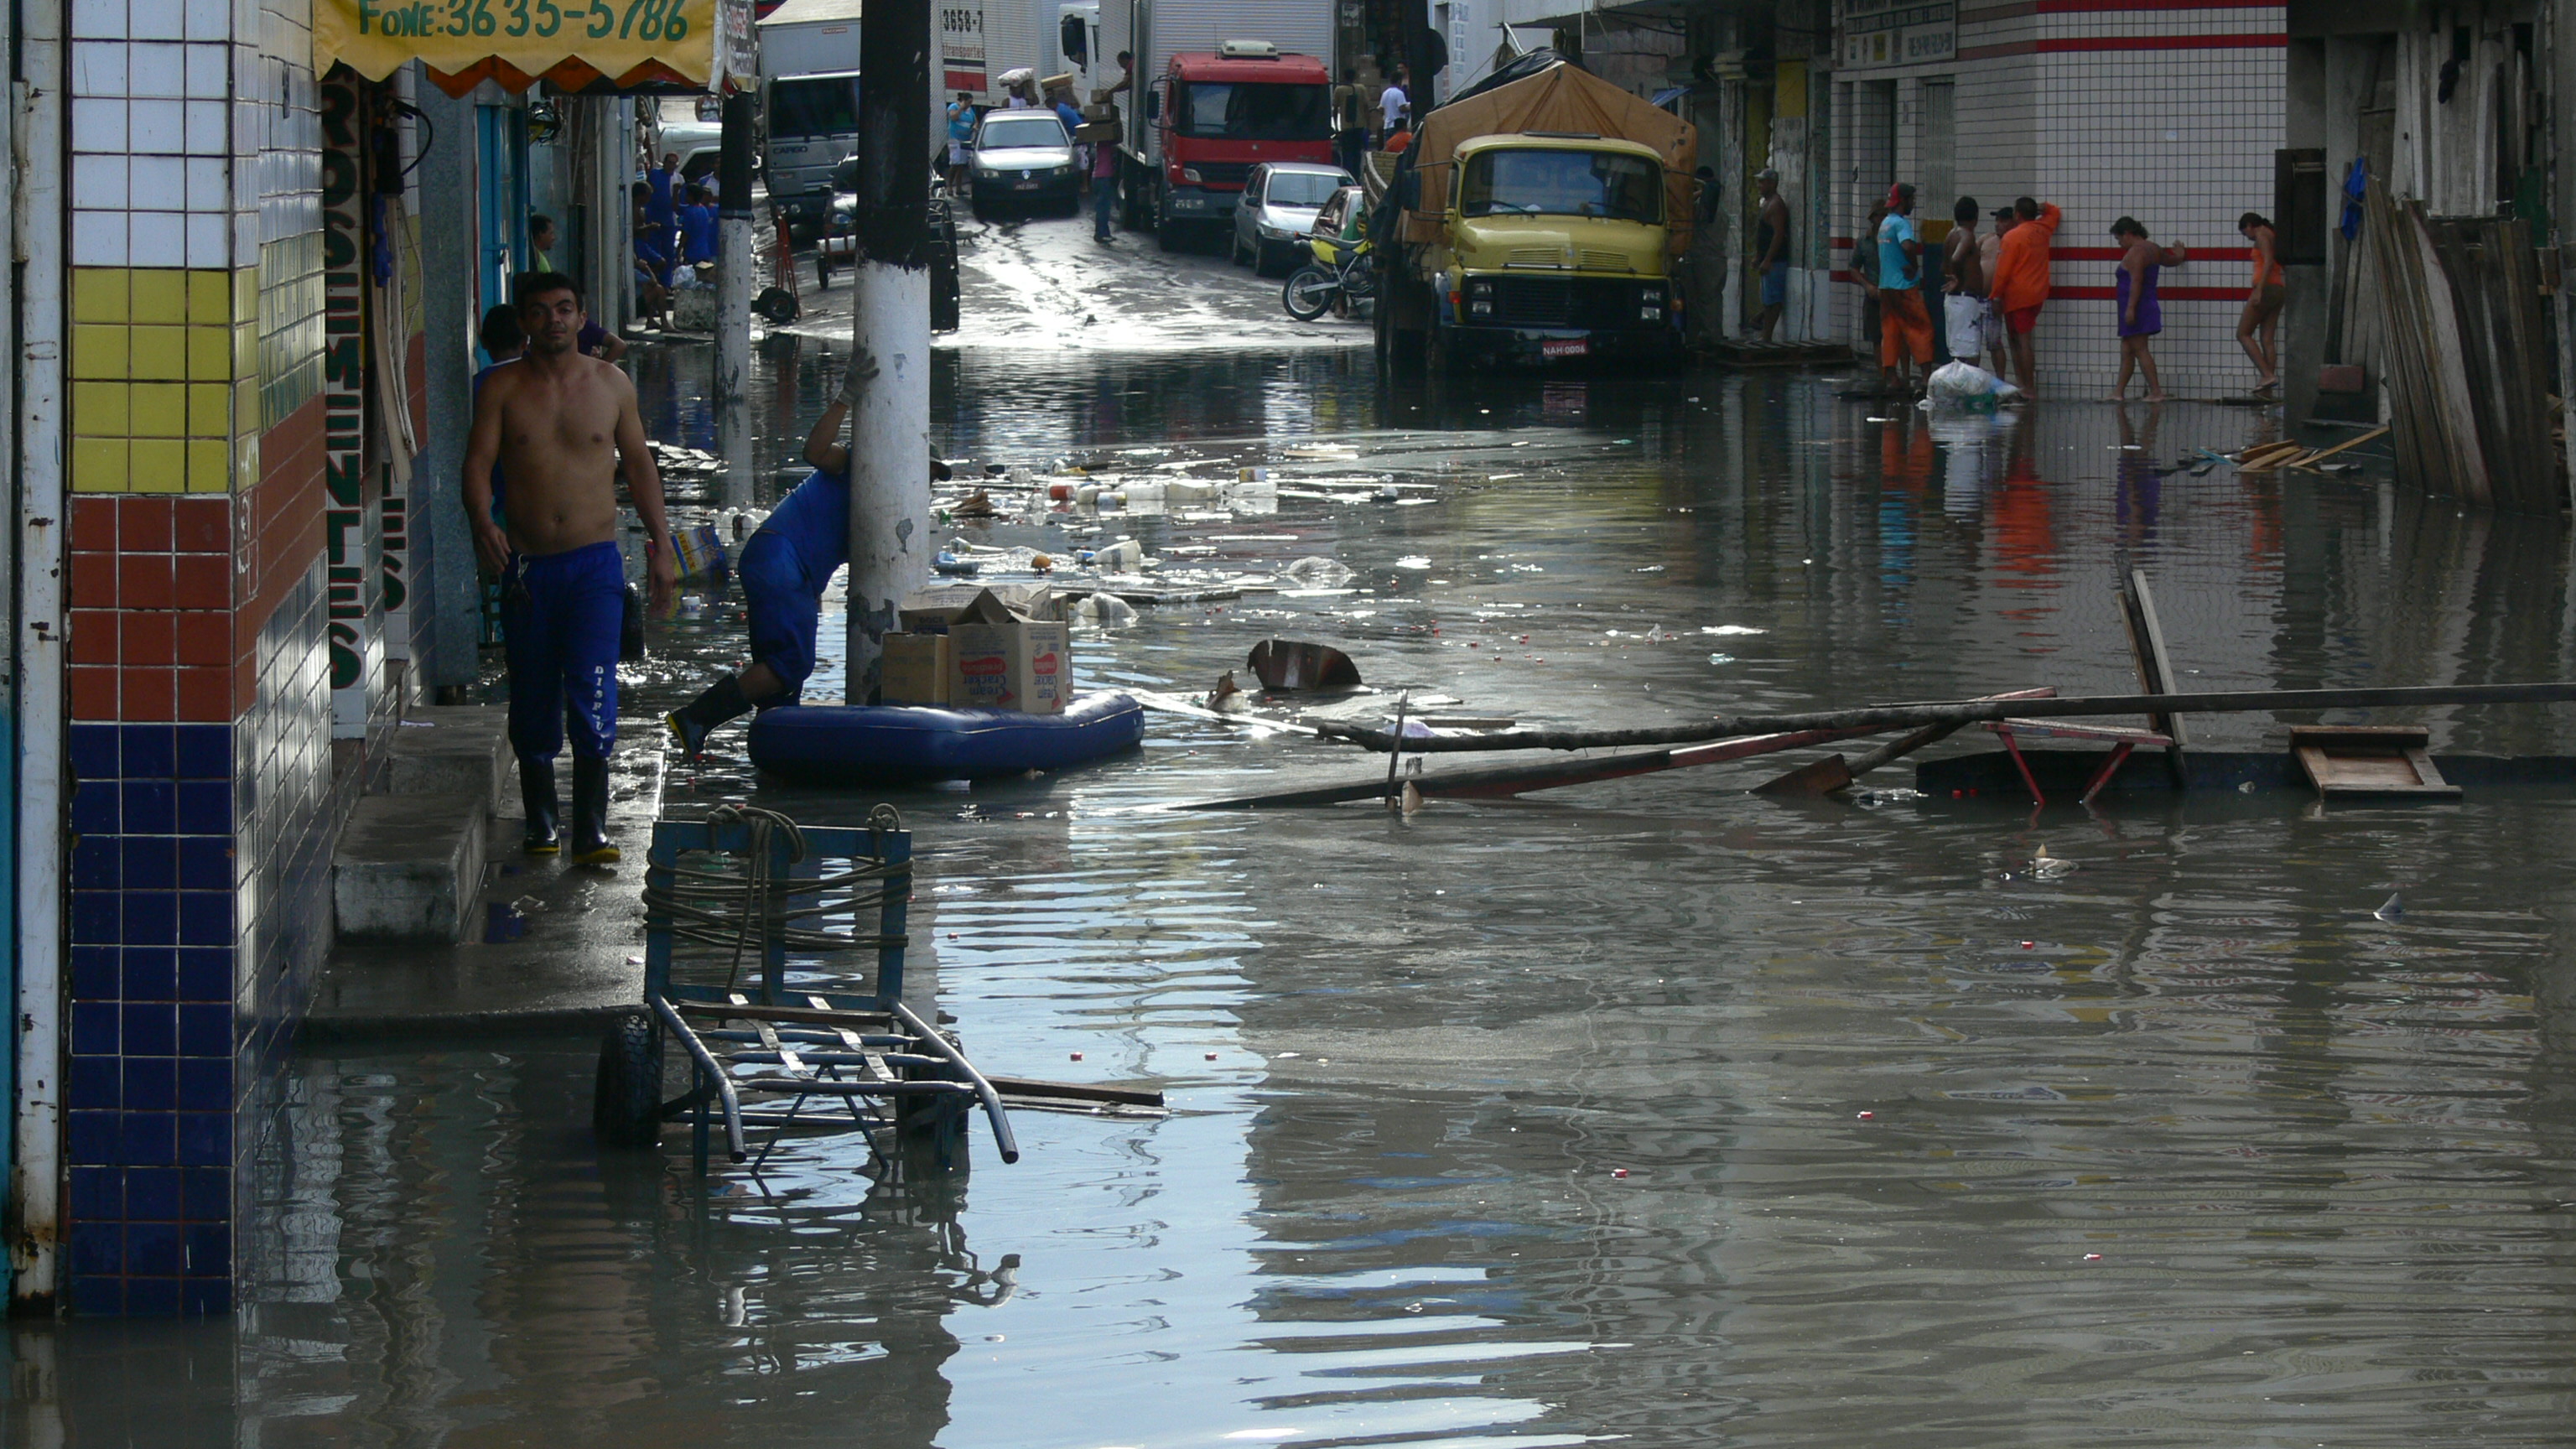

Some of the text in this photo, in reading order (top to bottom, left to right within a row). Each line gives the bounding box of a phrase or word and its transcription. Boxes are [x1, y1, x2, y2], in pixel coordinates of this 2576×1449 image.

[943, 9, 983, 34] 3658-7
[773, 146, 808, 154] CARGO
[963, 675, 1006, 685] Cracker
[969, 685, 1006, 697] Cream
